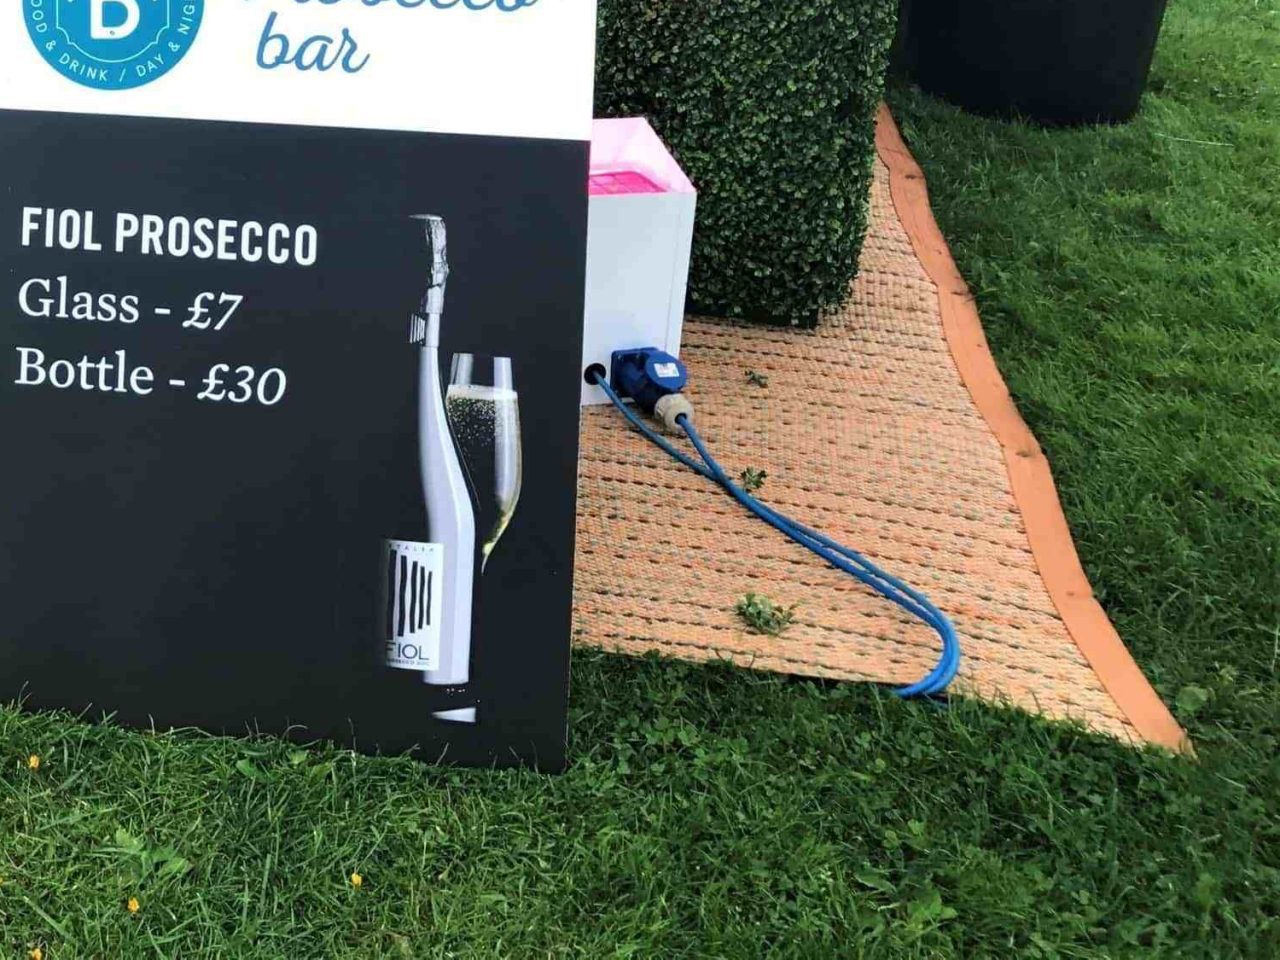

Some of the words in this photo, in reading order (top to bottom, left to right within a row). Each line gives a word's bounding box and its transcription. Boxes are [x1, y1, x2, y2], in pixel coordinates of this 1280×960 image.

[45, 40, 56, 51] &
[59, 52, 108, 82] DRINK
[135, 53, 165, 77] DAY
[168, 41, 181, 52] &
[255, 12, 370, 74] bar
[21, 206, 102, 251] FIOL
[115, 212, 318, 266] PROSECCO
[18, 275, 140, 323] Glass
[182, 291, 243, 330] £7
[14, 346, 154, 395] Bottle
[197, 363, 287, 406] £30
